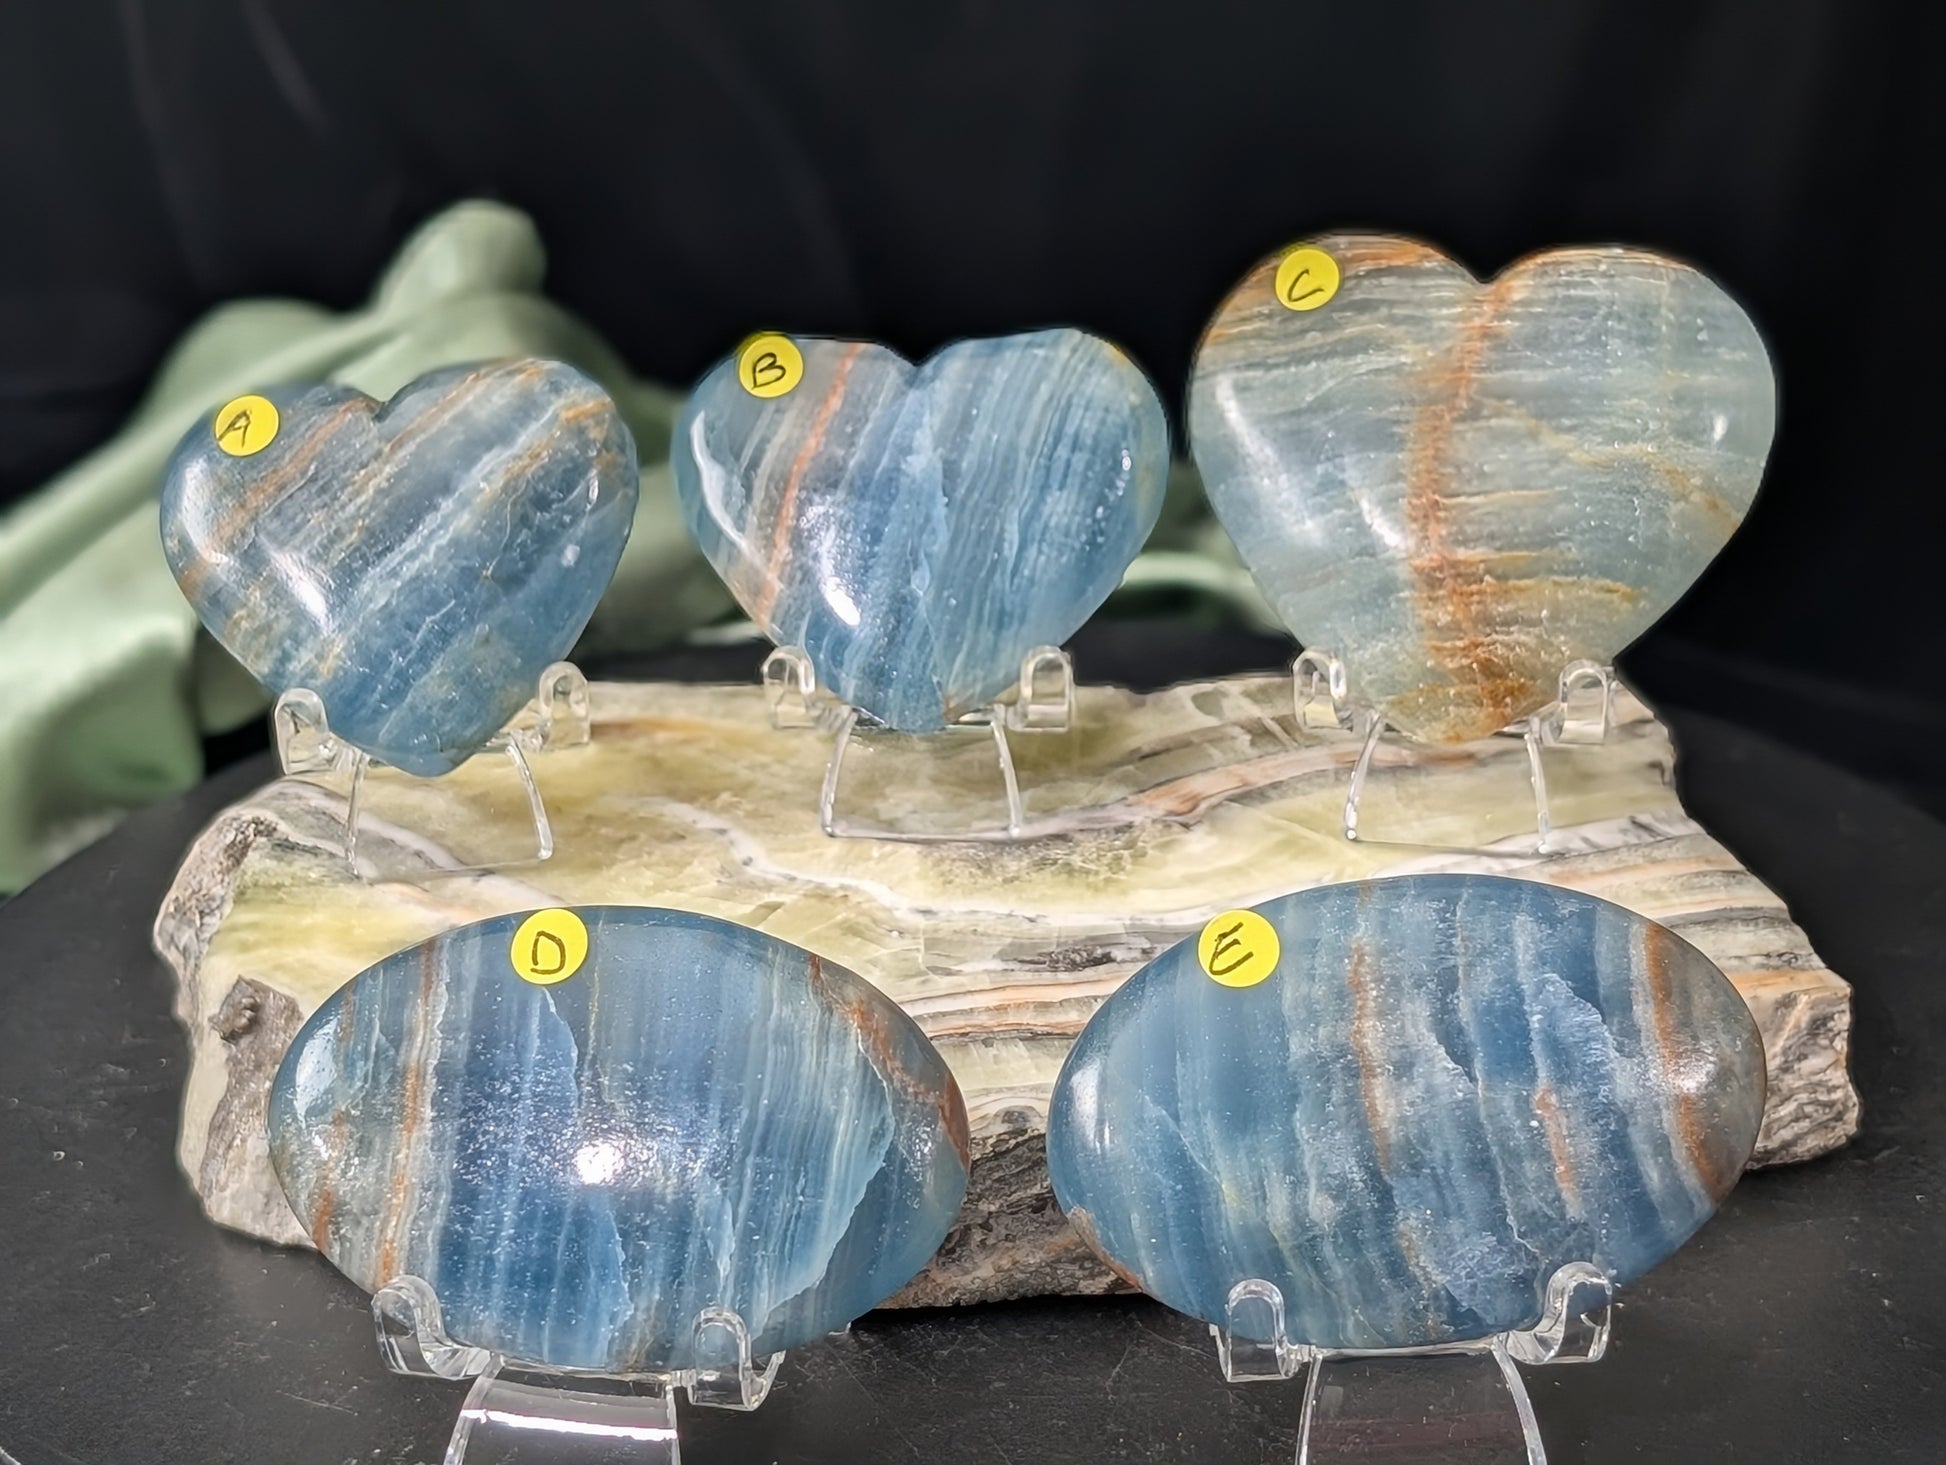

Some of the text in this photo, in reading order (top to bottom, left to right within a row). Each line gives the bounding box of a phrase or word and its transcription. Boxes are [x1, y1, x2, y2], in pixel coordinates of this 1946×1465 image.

[1288, 268, 1325, 303] C
[752, 352, 786, 390] B
[217, 409, 252, 447] A
[530, 930, 566, 975] D
[1209, 921, 1254, 976] E
